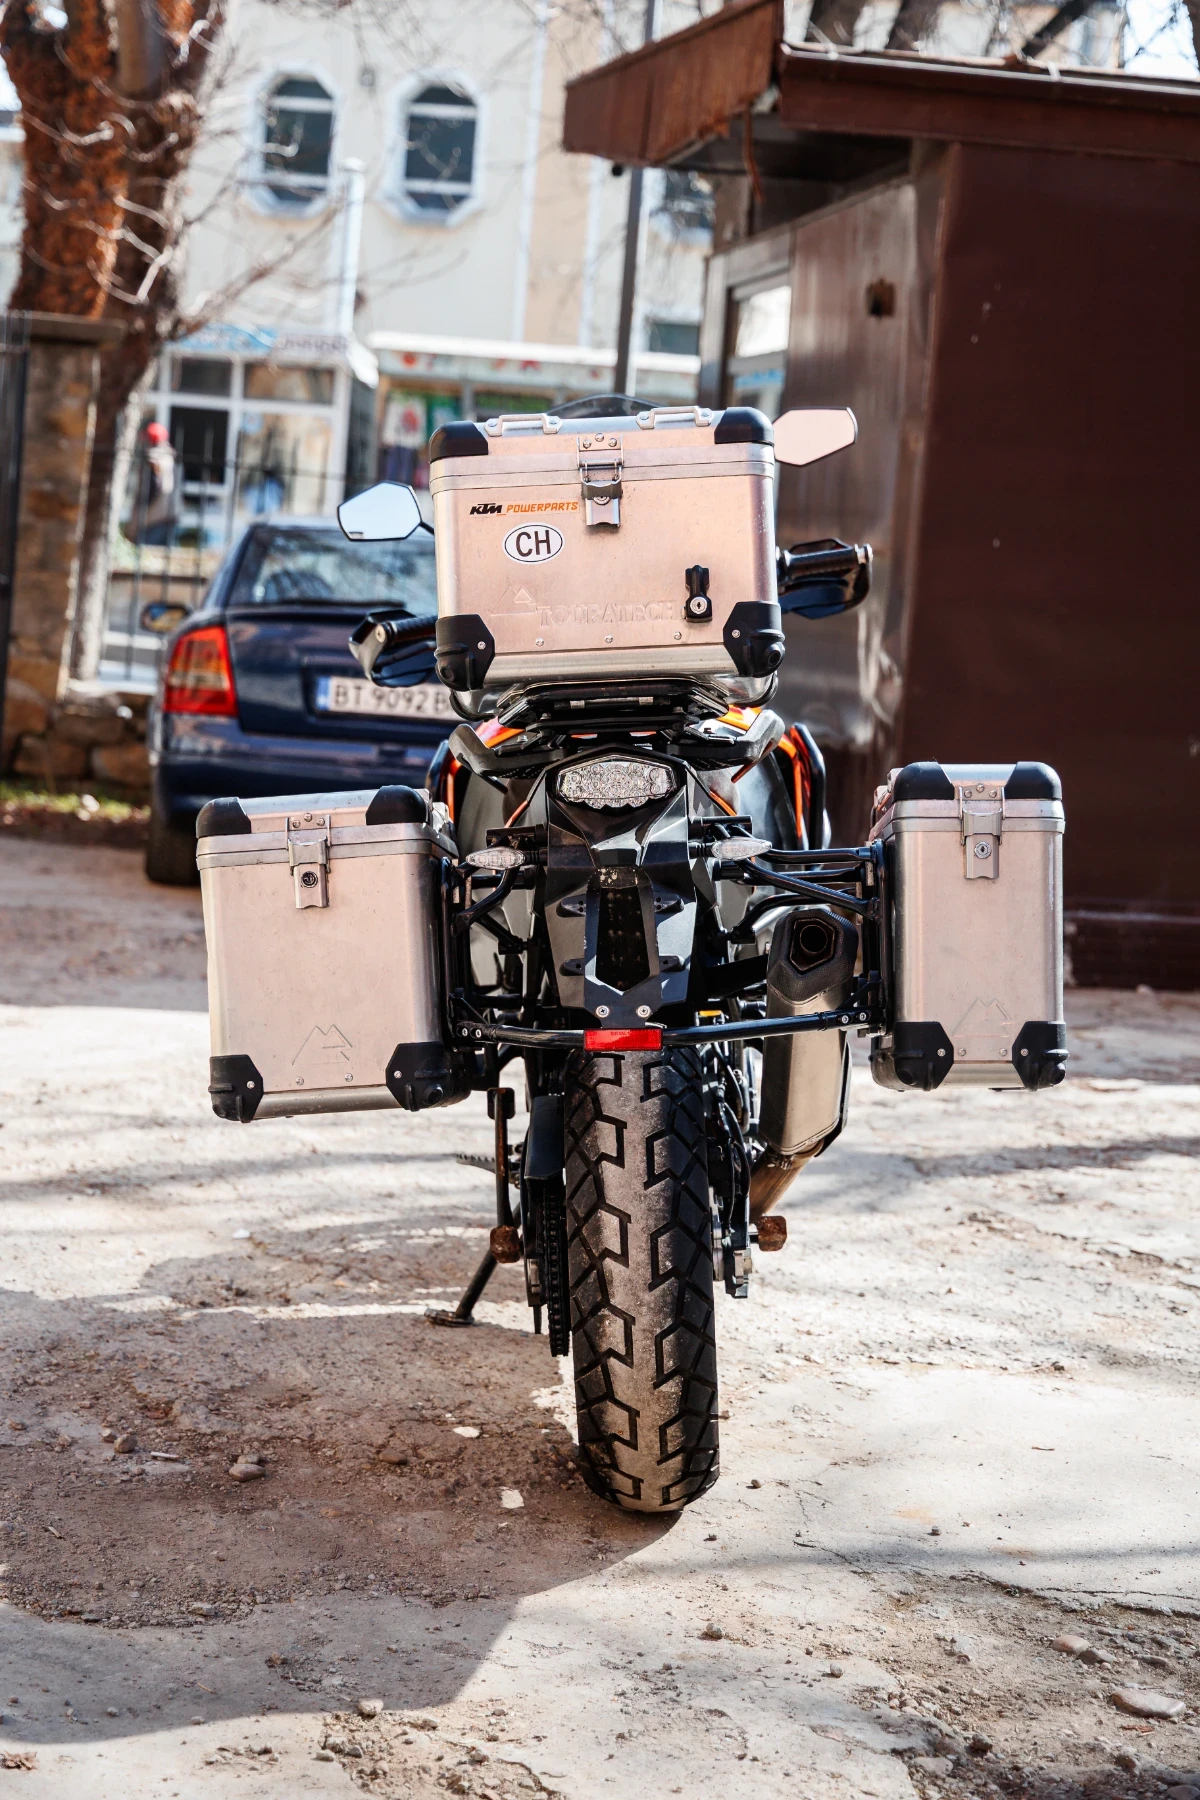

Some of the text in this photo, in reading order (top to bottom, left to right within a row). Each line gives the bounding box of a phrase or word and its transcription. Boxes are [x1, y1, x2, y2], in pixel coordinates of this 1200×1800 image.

[469, 501, 579, 515] KTM POWERPARTS
[515, 529, 552, 557] CH
[536, 600, 679, 626] TOURATECH
